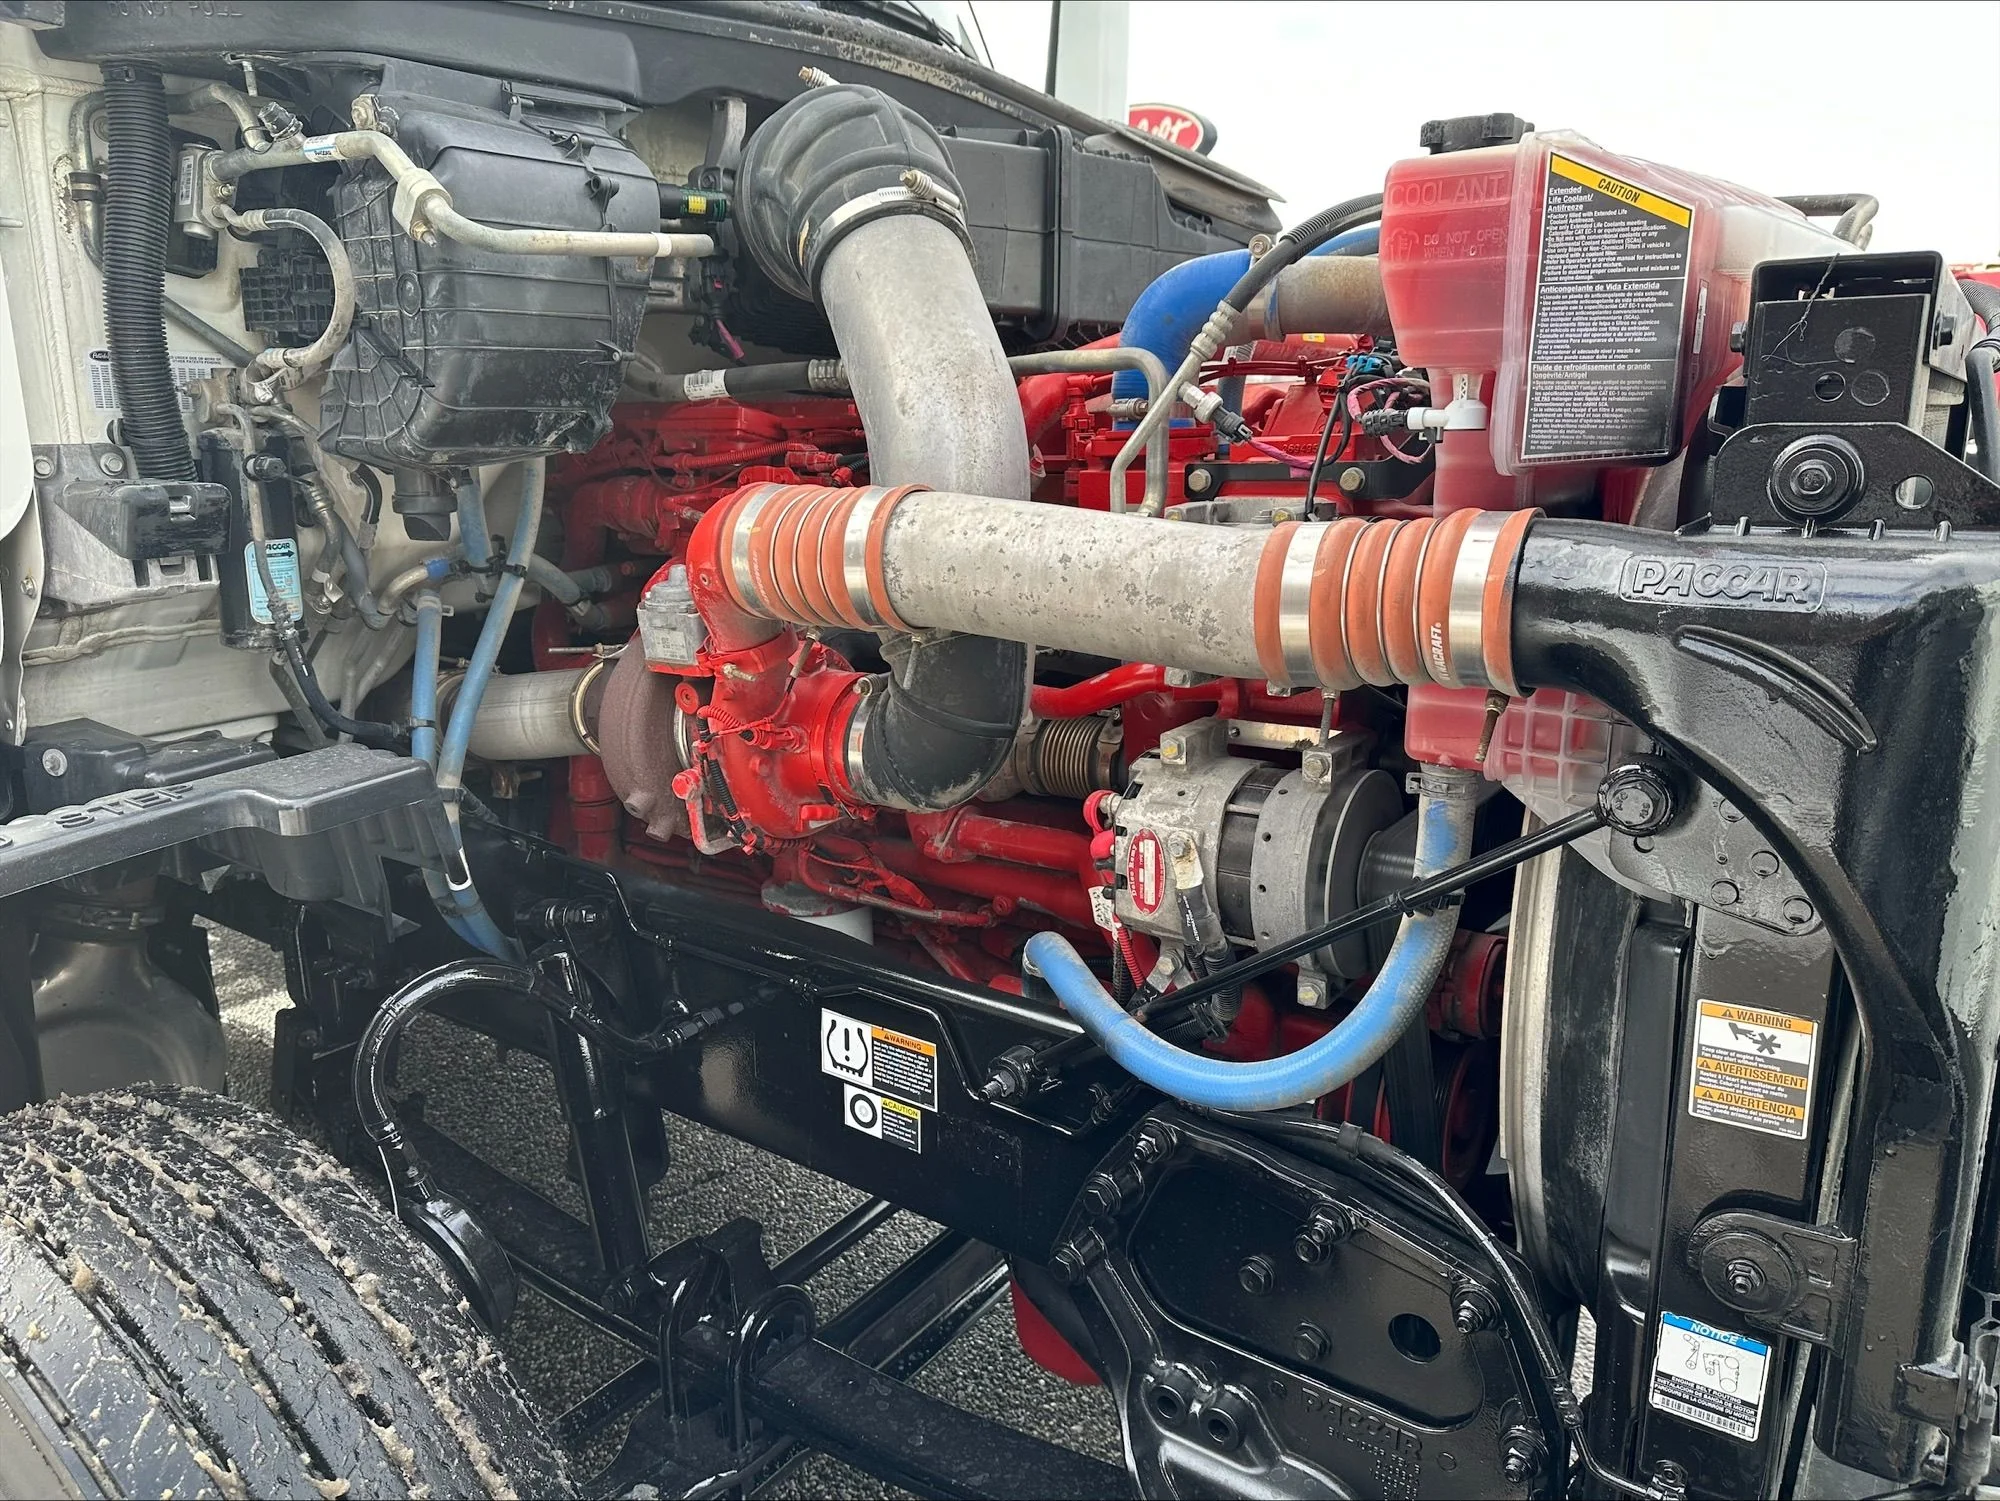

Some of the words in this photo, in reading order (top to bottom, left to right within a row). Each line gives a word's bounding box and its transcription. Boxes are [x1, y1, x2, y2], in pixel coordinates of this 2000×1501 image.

[1387, 174, 1506, 209] COOLANT
[1548, 195, 1561, 204] Life
[1549, 186, 1581, 195] Extended
[1597, 178, 1640, 203] CAUTION
[1547, 203, 1583, 213] Antifreeze
[1423, 234, 1440, 246] DO
[1445, 231, 1471, 245] NOT
[1423, 245, 1456, 259] WHEN
[1595, 283, 1604, 292] de
[1606, 283, 1622, 291] Vida
[1623, 281, 1660, 291] Extendida
[266, 543, 291, 551] ACCAR
[1632, 560, 1812, 605] PACCAR
[55, 784, 195, 829] STEP
[1128, 843, 1138, 869] Remy
[1129, 870, 1138, 897] Delco
[1737, 1010, 1792, 1029] WARNING
[890, 1035, 922, 1052] WARNING
[1715, 1062, 1805, 1088] AVERTISSEMENT
[887, 1101, 918, 1118] CAUTION
[1717, 1092, 1797, 1117] ADVERTENCIA
[1690, 1323, 1738, 1344] NOTICE
[1302, 1387, 1423, 1462] PACCAR
